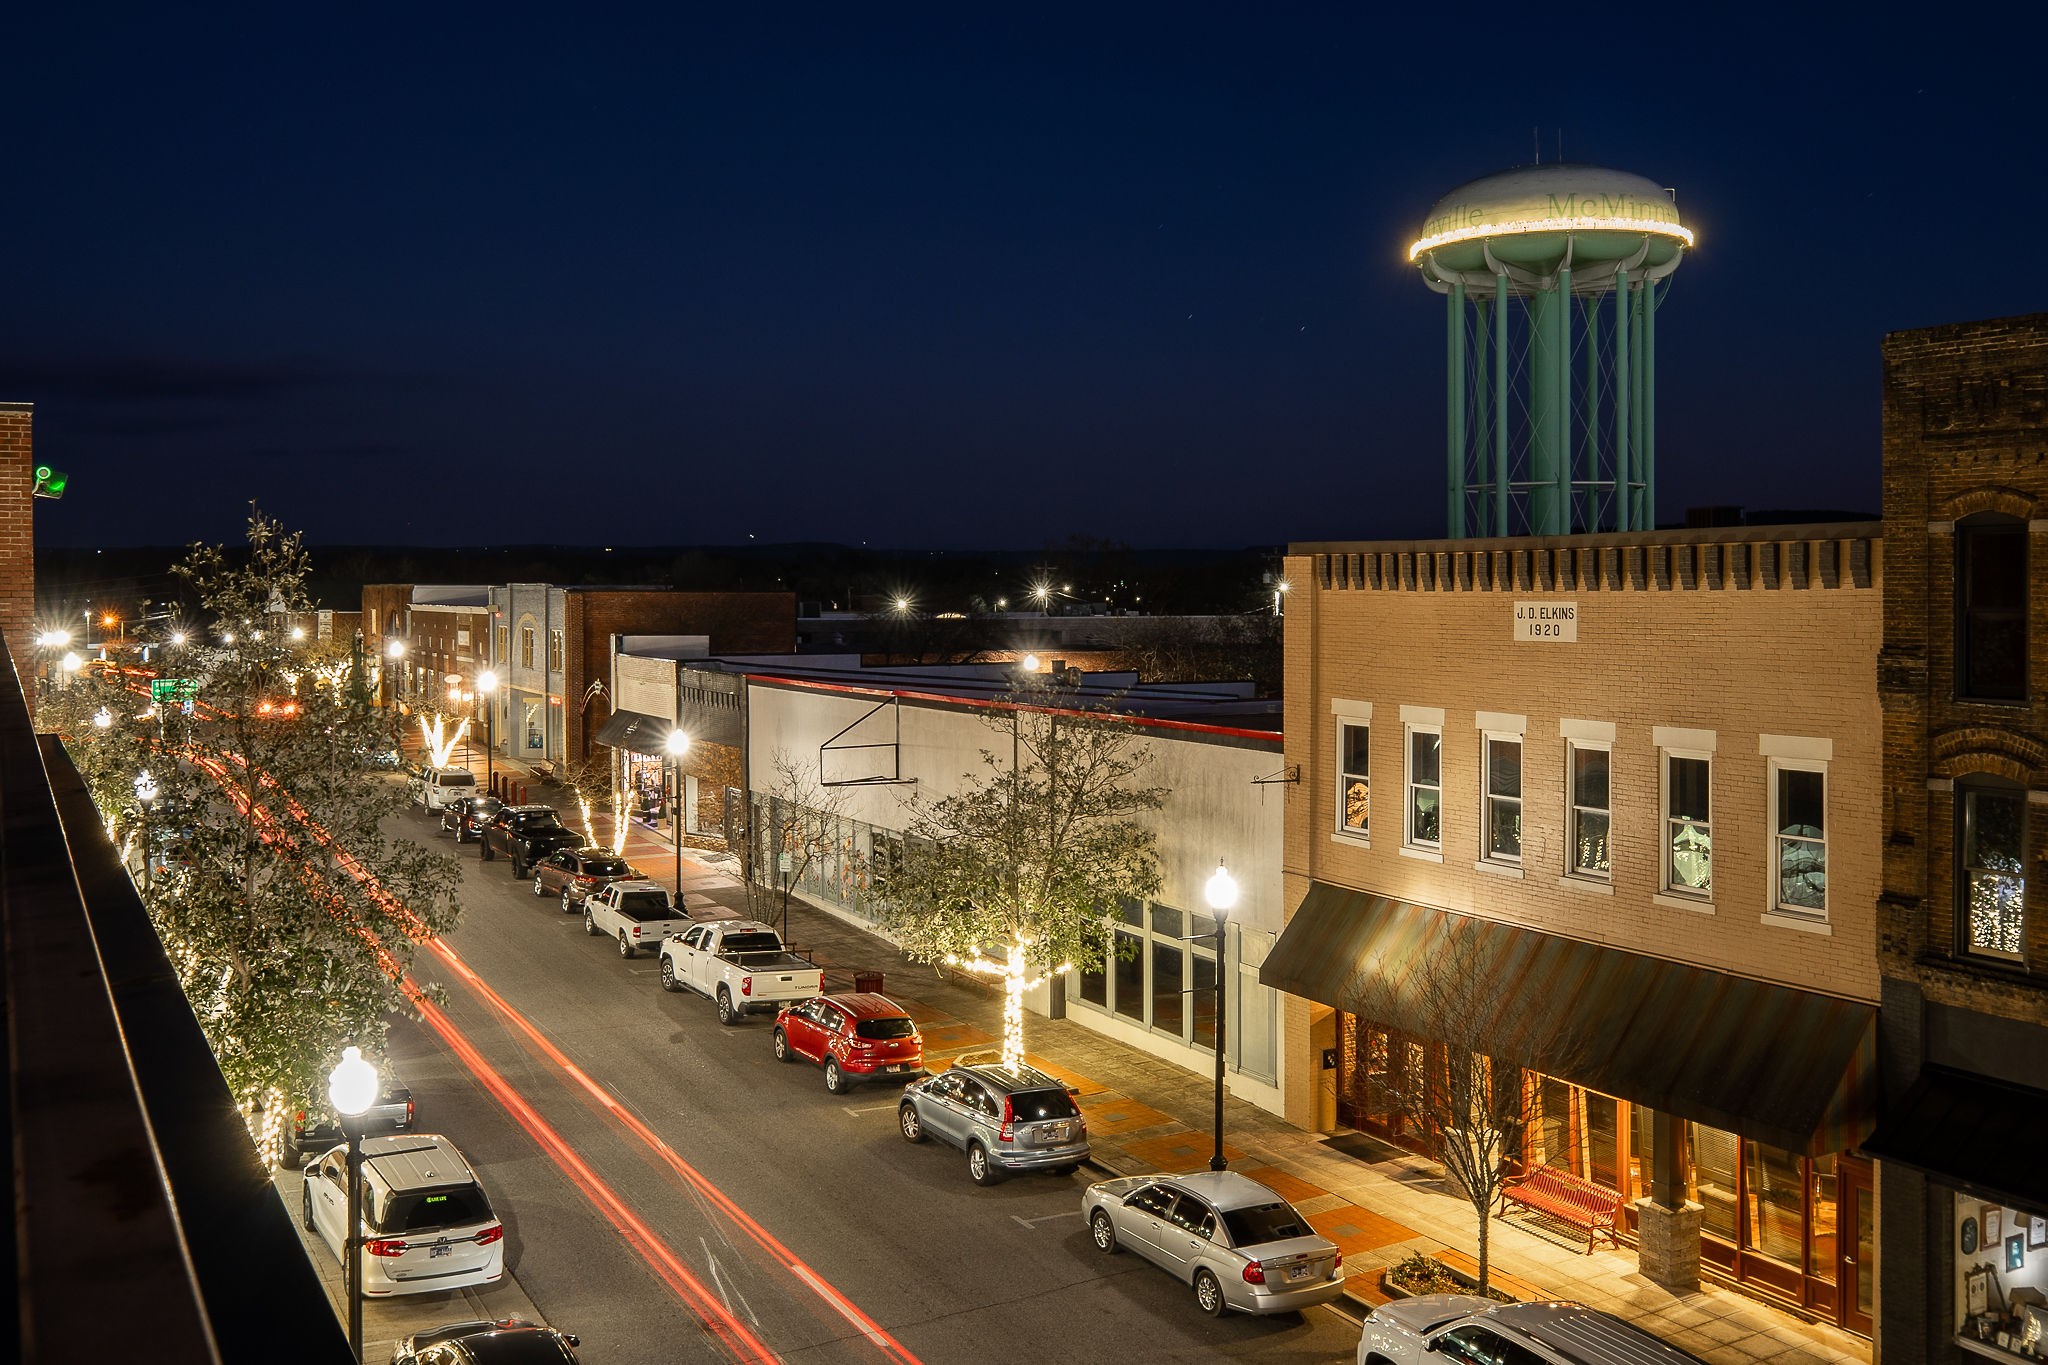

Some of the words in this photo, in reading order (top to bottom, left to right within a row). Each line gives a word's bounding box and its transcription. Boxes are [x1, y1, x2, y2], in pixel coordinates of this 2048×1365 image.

[1517, 607, 1526, 619] J.
[1528, 607, 1537, 619] D.
[1540, 607, 1575, 619] ELKINS
[1529, 623, 1560, 636] 1920
